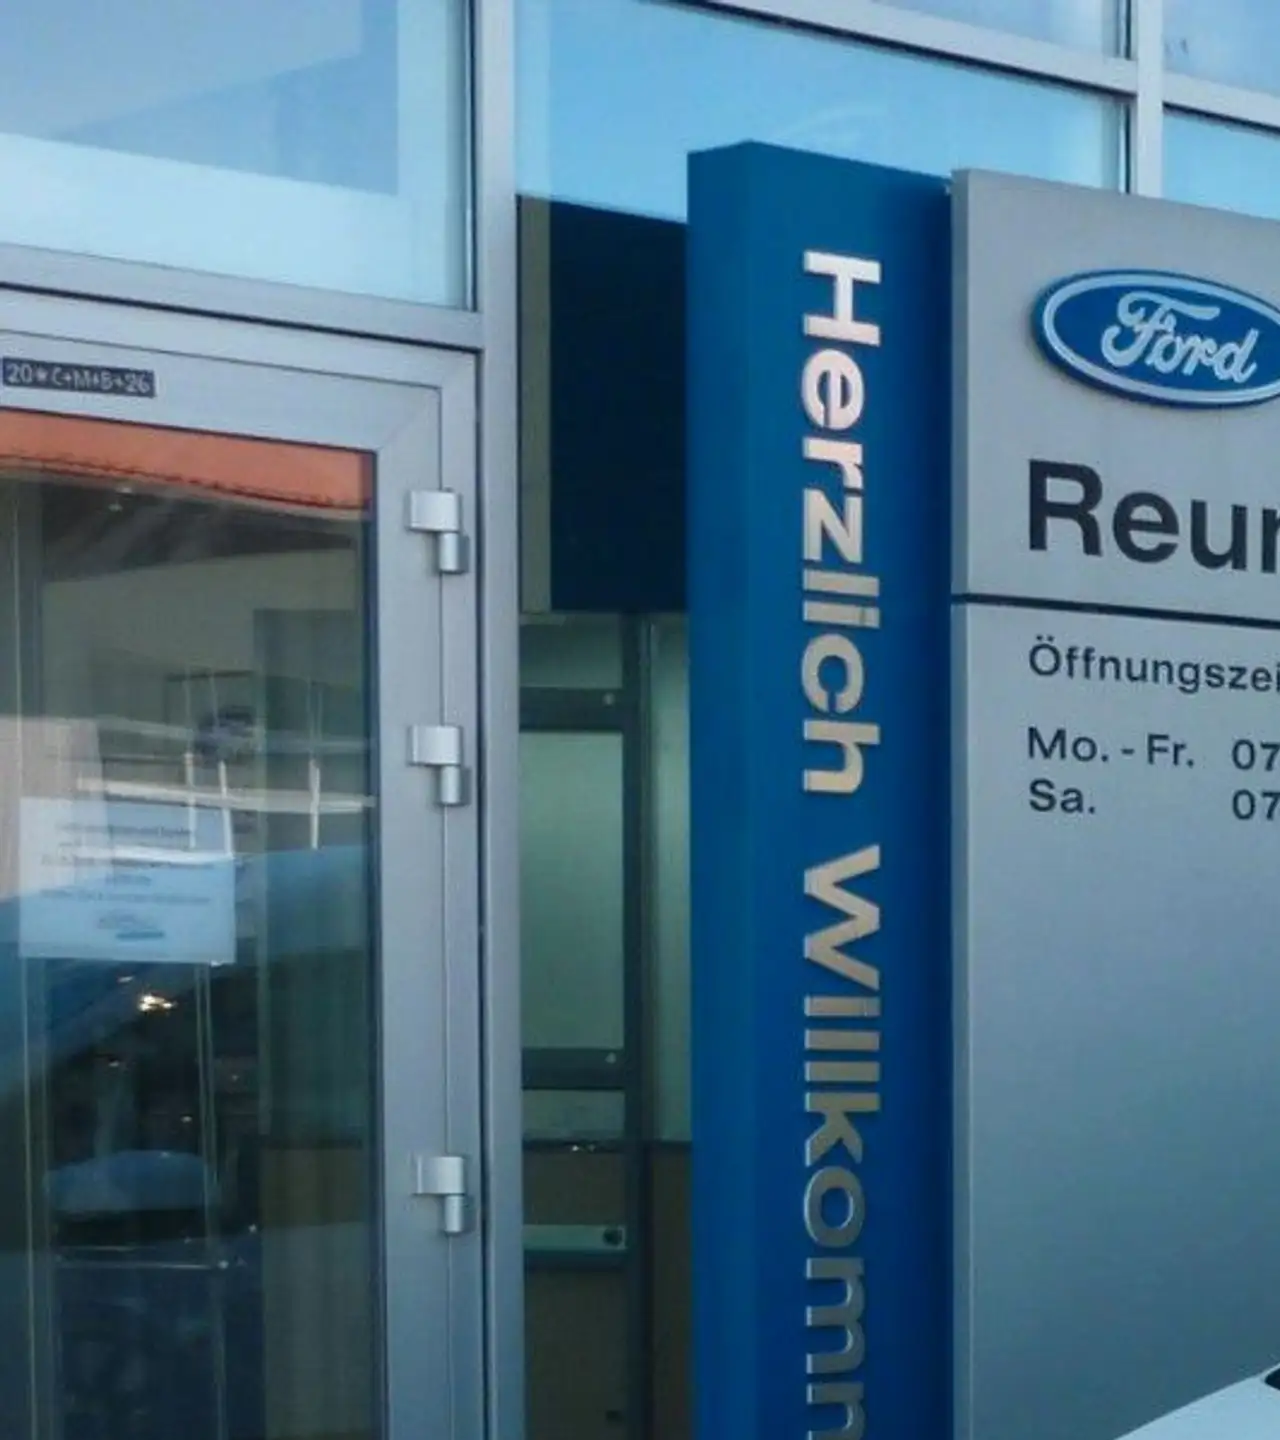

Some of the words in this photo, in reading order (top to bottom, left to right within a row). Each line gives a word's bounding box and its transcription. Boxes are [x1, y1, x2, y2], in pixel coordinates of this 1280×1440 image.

[1101, 290, 1259, 384] Ford
[802, 250, 881, 794] Herzlich
[1027, 726, 1109, 763] Mo.
[1147, 733, 1196, 769] Fr.
[1028, 778, 1096, 815] Sa.
